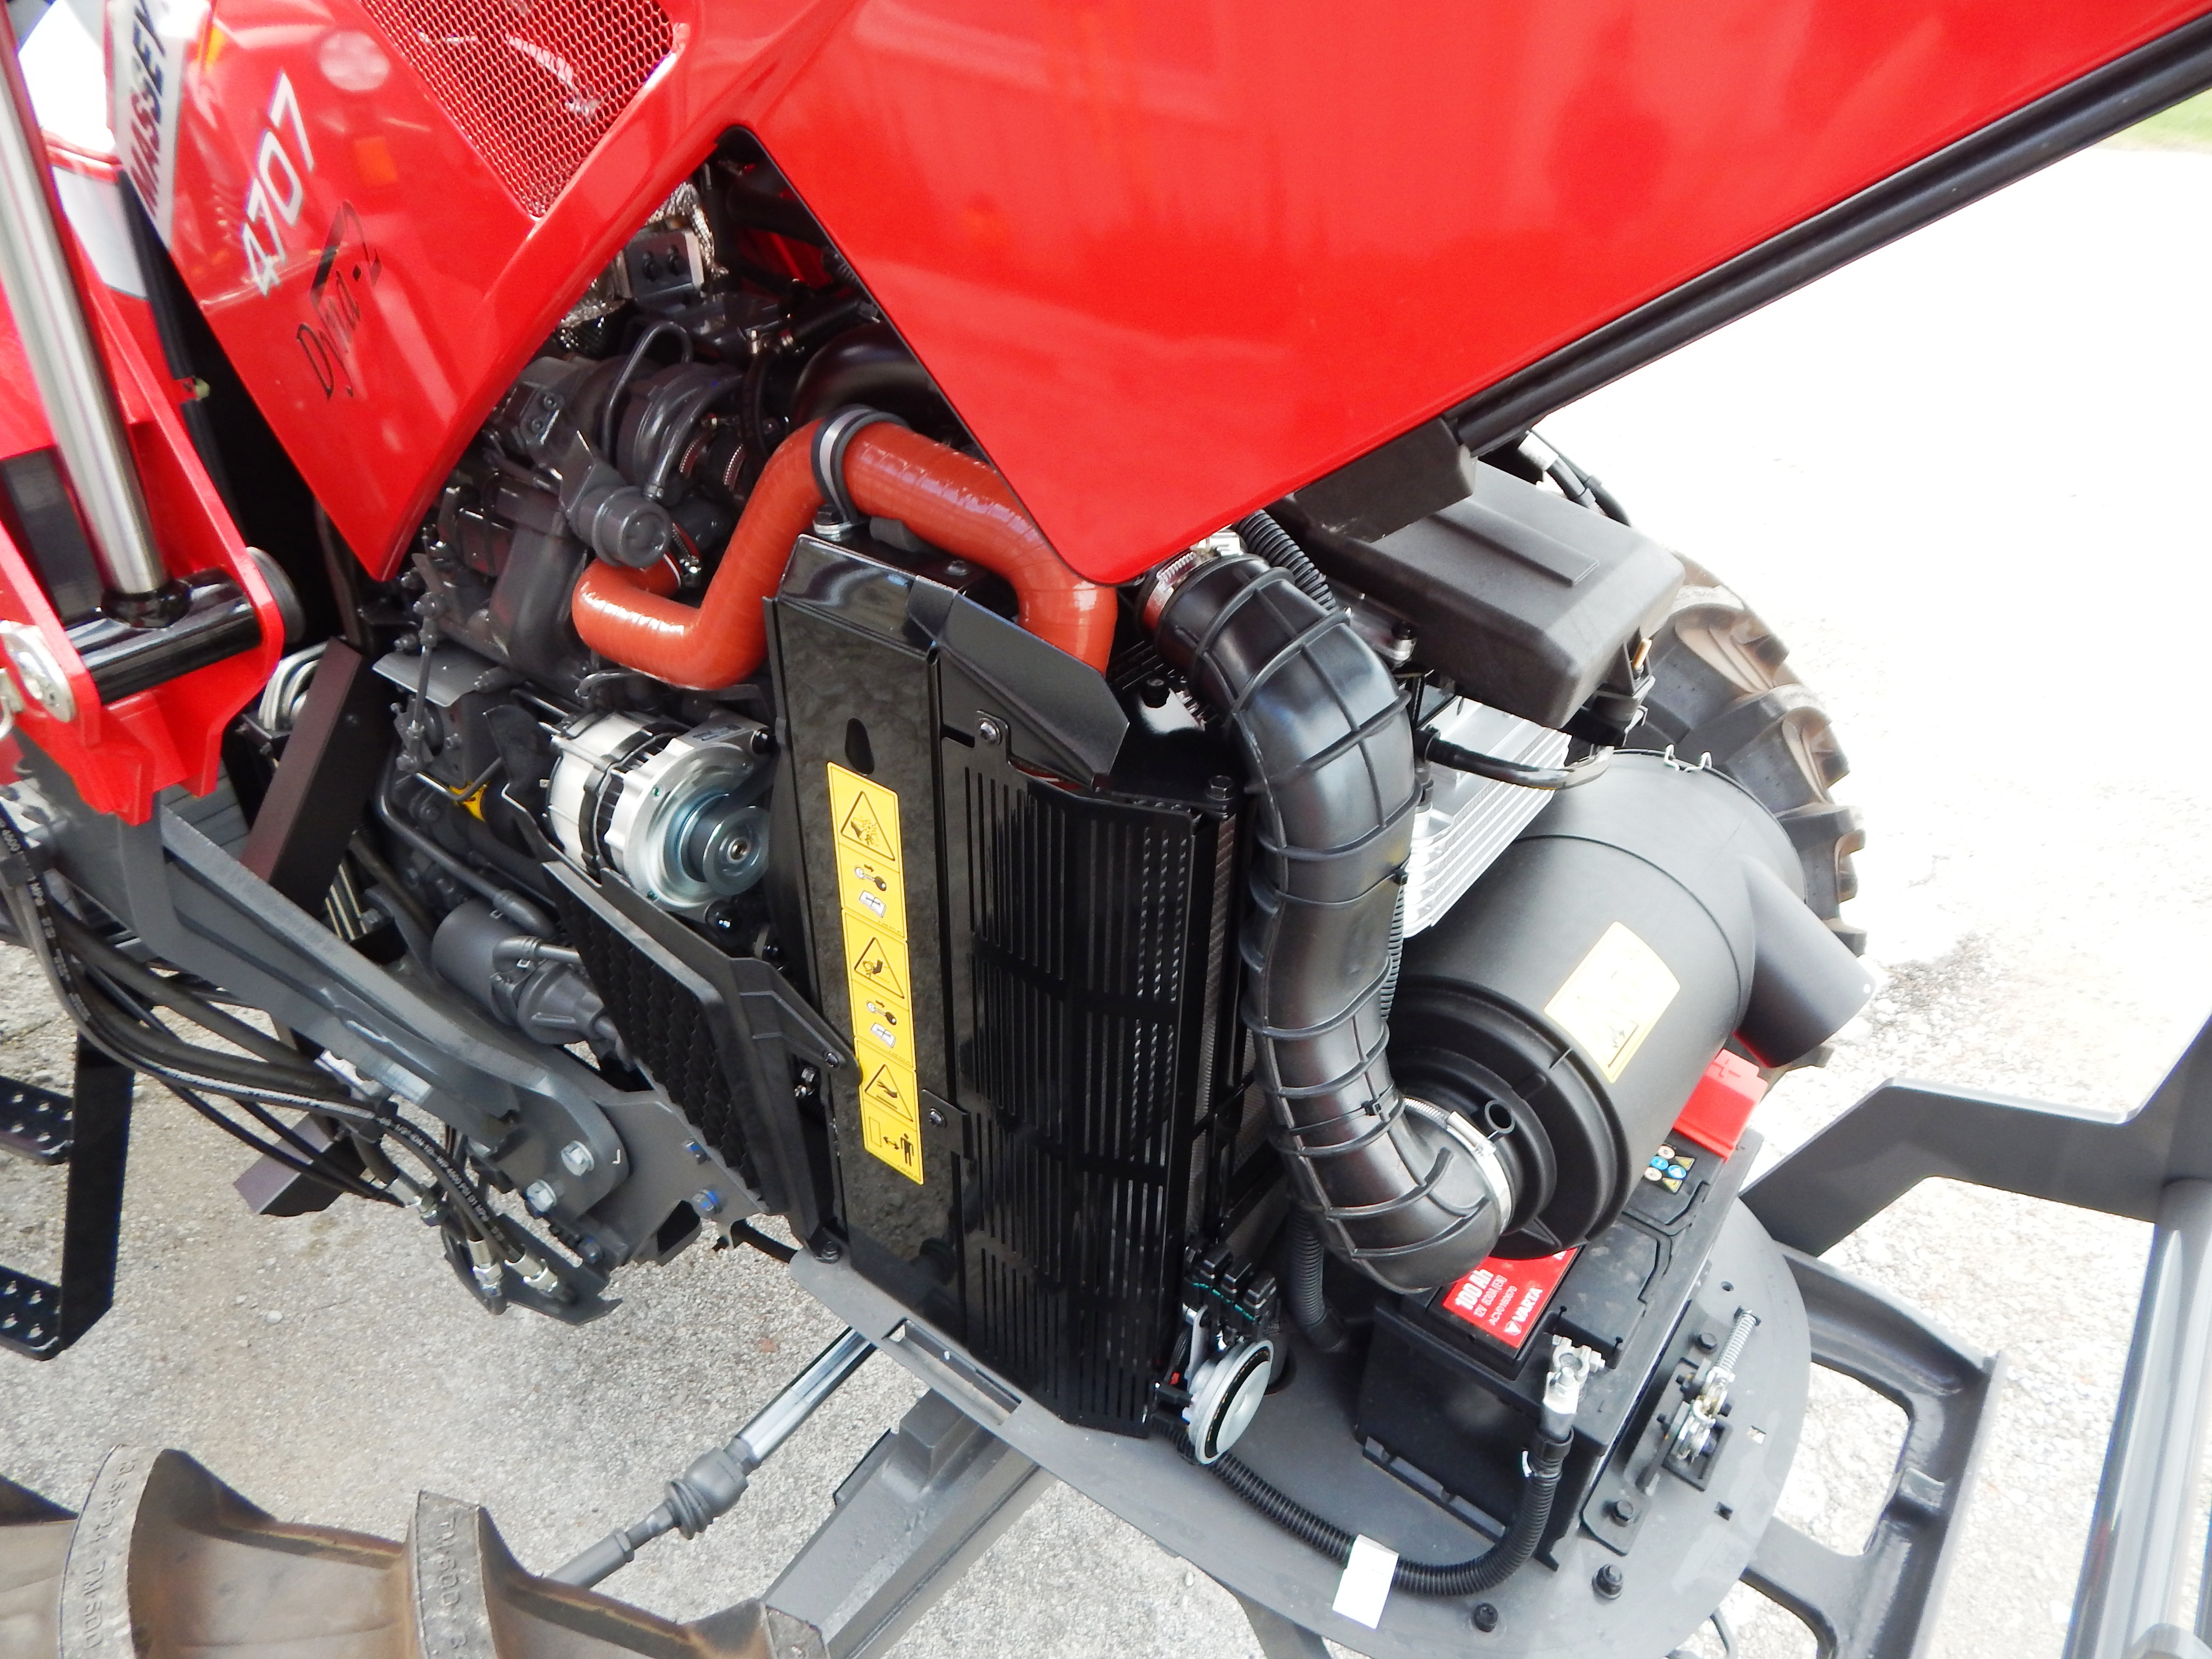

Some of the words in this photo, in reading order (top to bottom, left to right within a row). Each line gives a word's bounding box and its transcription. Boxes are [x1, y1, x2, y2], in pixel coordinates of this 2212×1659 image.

[241, 67, 315, 298] 4707
[1455, 1283, 1483, 1310] 100
[1468, 1269, 1494, 1289] Ah
[1473, 1304, 1487, 1318] 12V
[1491, 1274, 1507, 1291] (EN)
[1512, 1287, 1543, 1322] VARTA
